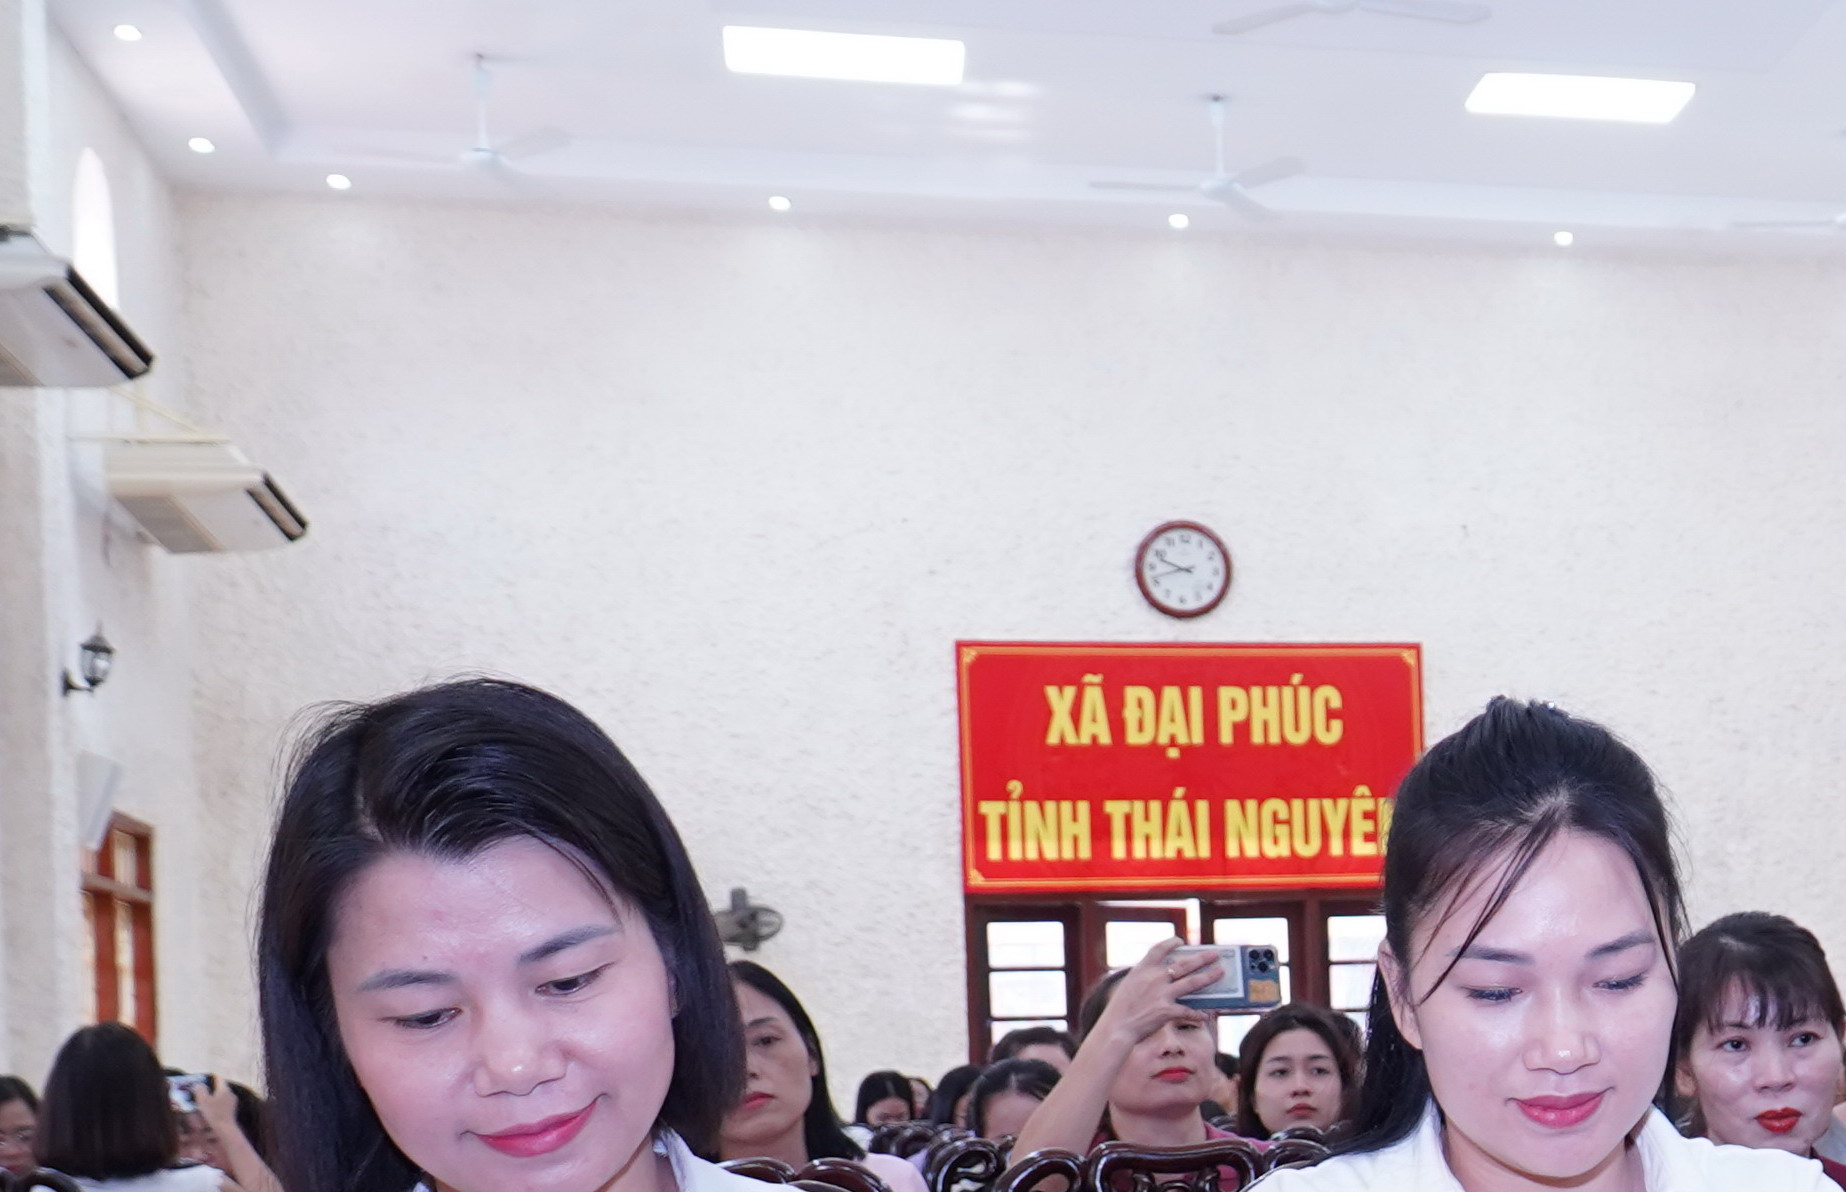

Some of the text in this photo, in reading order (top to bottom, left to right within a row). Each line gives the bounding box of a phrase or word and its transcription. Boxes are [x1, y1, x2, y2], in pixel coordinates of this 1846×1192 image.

[1045, 673, 1343, 759] XÃ ĐẠI PHÚC
[979, 780, 1092, 861] TỈNH
[1104, 786, 1211, 860] THÁI
